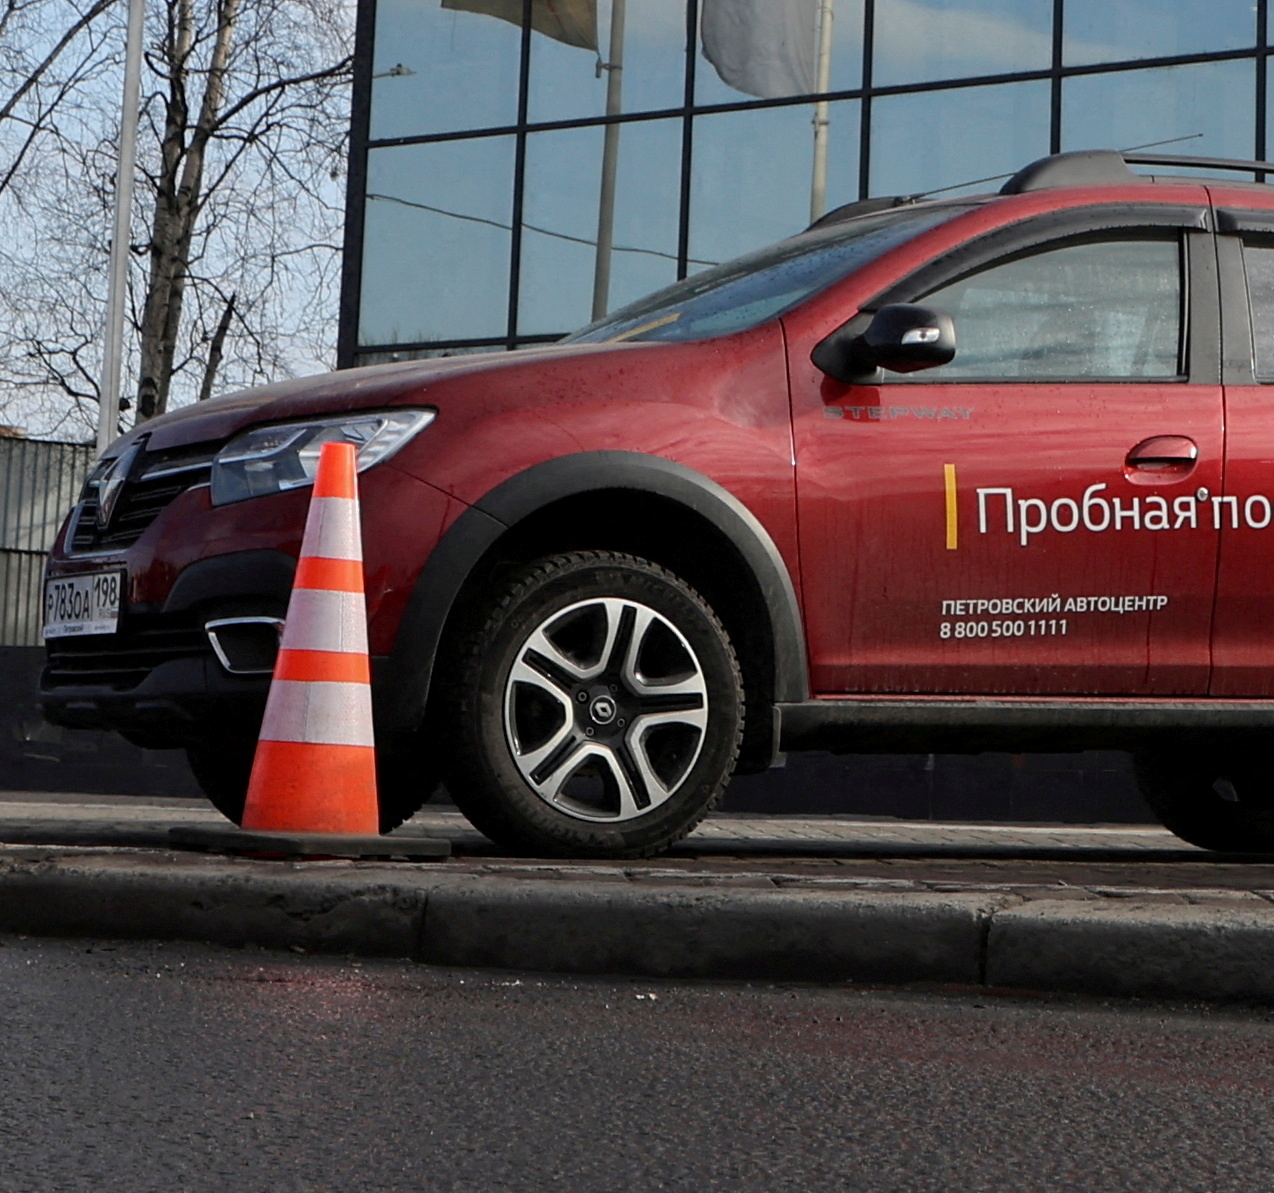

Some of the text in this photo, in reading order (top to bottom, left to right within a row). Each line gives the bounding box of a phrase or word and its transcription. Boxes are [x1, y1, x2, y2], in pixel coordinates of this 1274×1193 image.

[823, 406, 974, 420] STEPWAY
[976, 483, 1198, 546] Пробная
[94, 576, 117, 607] 198
[942, 594, 1168, 615] ПЕТРОВСКИЙ АВТОЦЕНТР
[940, 619, 1067, 638] 8 800 500 1111
